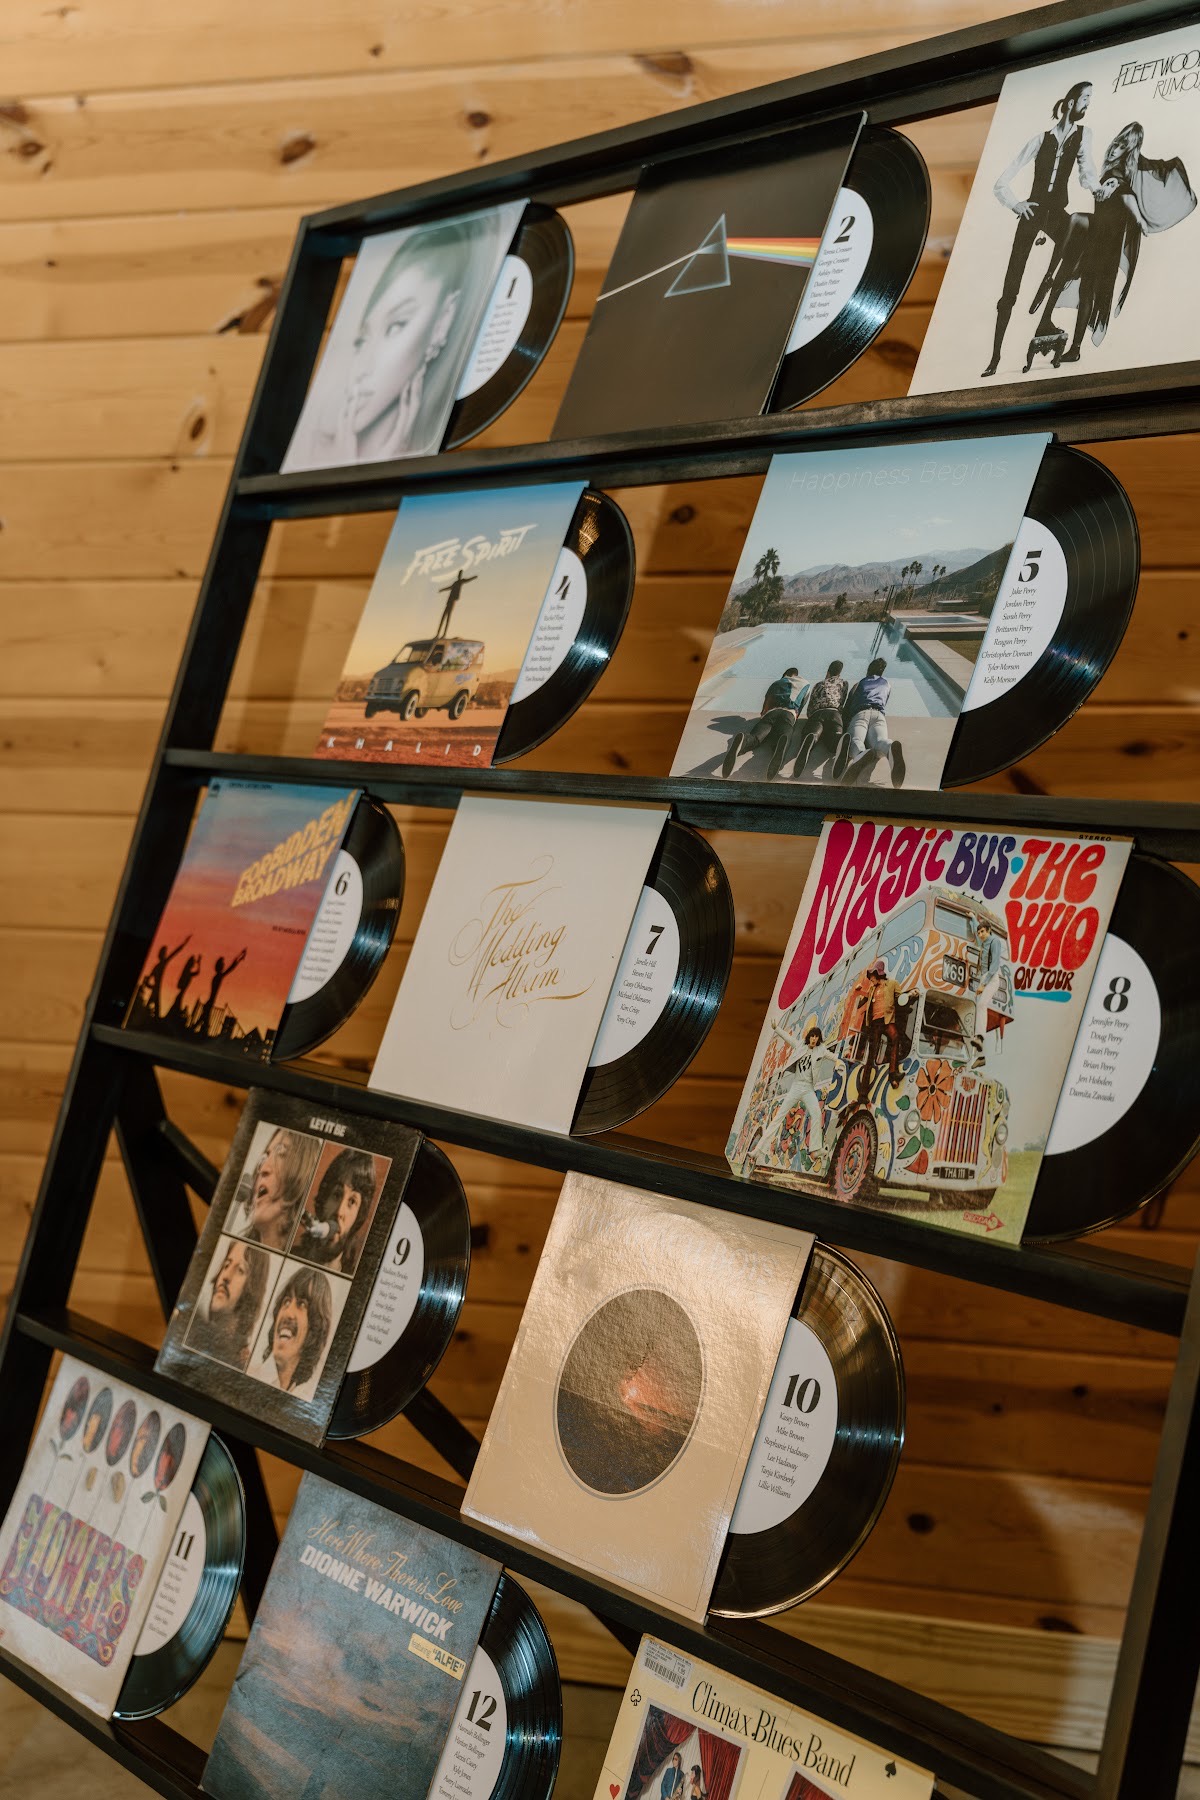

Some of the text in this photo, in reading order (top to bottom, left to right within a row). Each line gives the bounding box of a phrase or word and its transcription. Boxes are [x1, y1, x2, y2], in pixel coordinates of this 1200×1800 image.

[1112, 50, 1200, 94] FLEETWOO
[833, 215, 856, 244] 2
[506, 276, 519, 299] 1
[789, 456, 1009, 497] Happiness Begins
[1018, 547, 1043, 582] 5
[554, 574, 575, 601] 4
[1009, 586, 1037, 598] Jake Perry
[1002, 598, 1037, 611] Jordan Perry
[1002, 612, 1033, 622] Sarah Perry
[1018, 624, 1033, 635] Perry
[1013, 637, 1028, 647] Perry
[981, 650, 1012, 661] Christopher
[326, 736, 482, 757] KHALID
[1078, 834, 1112, 842] STEREO
[945, 832, 1016, 900] BUS
[335, 871, 351, 896] 6
[645, 924, 666, 955] 7
[1004, 900, 1100, 971] WHO
[1014, 967, 1076, 992] ON TOUR
[1103, 976, 1131, 1013] 8
[1088, 1016, 1130, 1031] Jennifer Perry
[1090, 1031, 1123, 1045] Doug Perry
[1103, 1047, 1119, 1060] Perry
[1082, 1059, 1116, 1074] Brian Perry
[1075, 1074, 1088, 1085] Jen
[309, 1117, 327, 1132] LET
[333, 1123, 347, 1137] BE
[393, 1237, 411, 1266] 9
[781, 1373, 822, 1414] 10
[775, 1425, 805, 1442] Mike Brown
[793, 1416, 810, 1429] Brown
[763, 1436, 787, 1451] Stephanie
[766, 1452, 776, 1462] Lee
[770, 1484, 792, 1499] Williams
[174, 1530, 196, 1561] 11
[305, 1515, 344, 1550] Here
[426, 1572, 465, 1614] Love
[299, 1544, 455, 1641] DIONNE WARWICK
[465, 1690, 498, 1732] 12
[692, 1680, 856, 1788] Climax Blues Band
